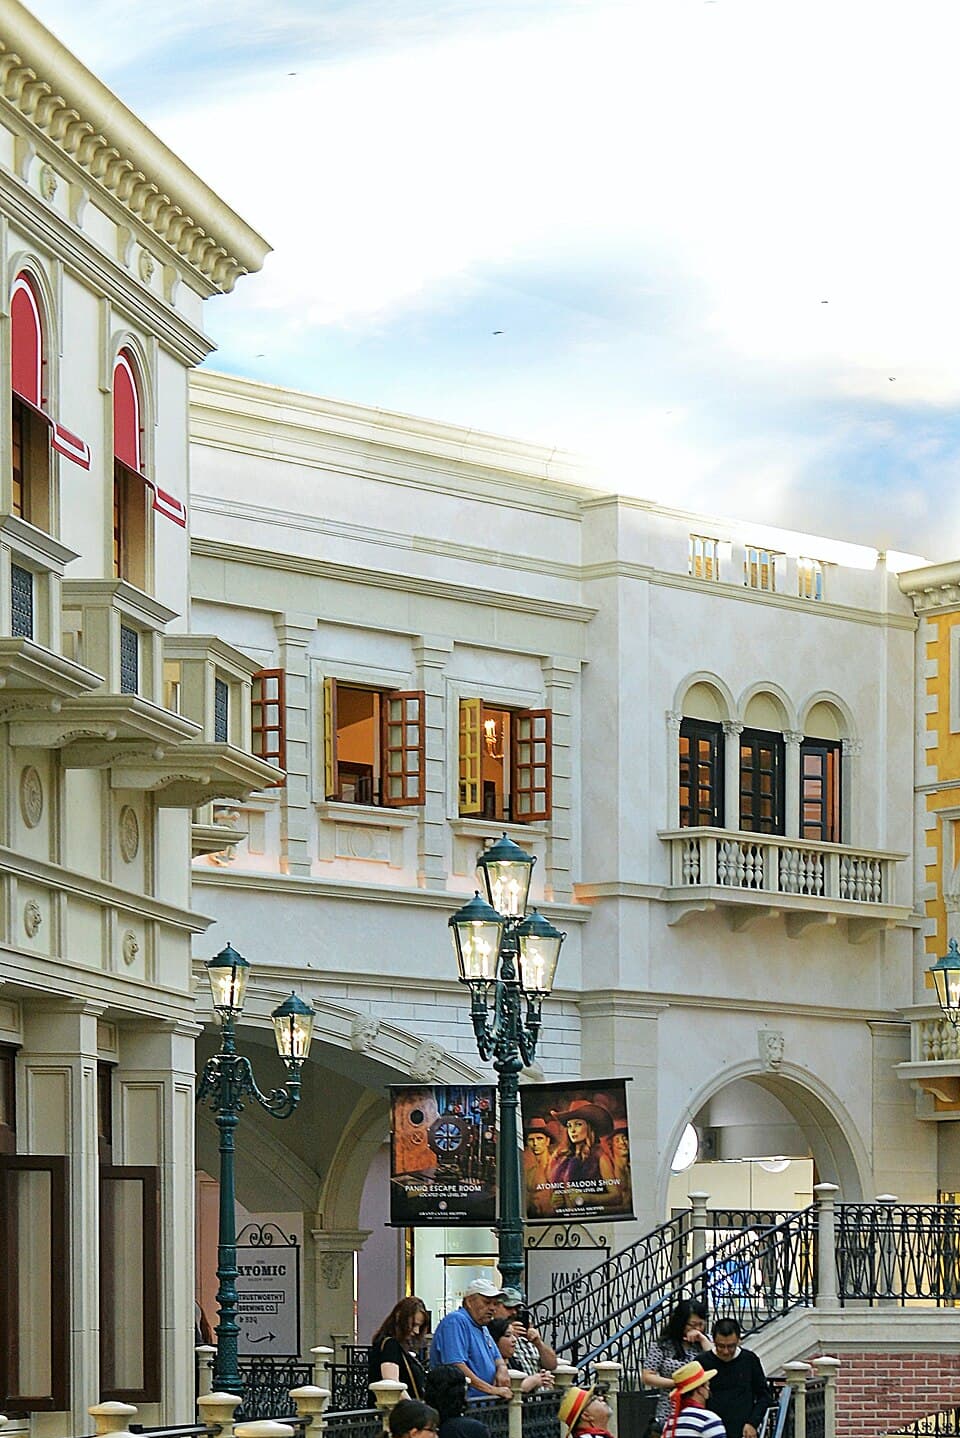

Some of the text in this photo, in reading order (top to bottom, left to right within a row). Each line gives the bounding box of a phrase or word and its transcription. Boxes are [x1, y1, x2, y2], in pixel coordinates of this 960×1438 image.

[566, 1180, 597, 1188] SALOON
[598, 1178, 620, 1187] SHOW
[237, 1265, 286, 1276] ATOMIC
